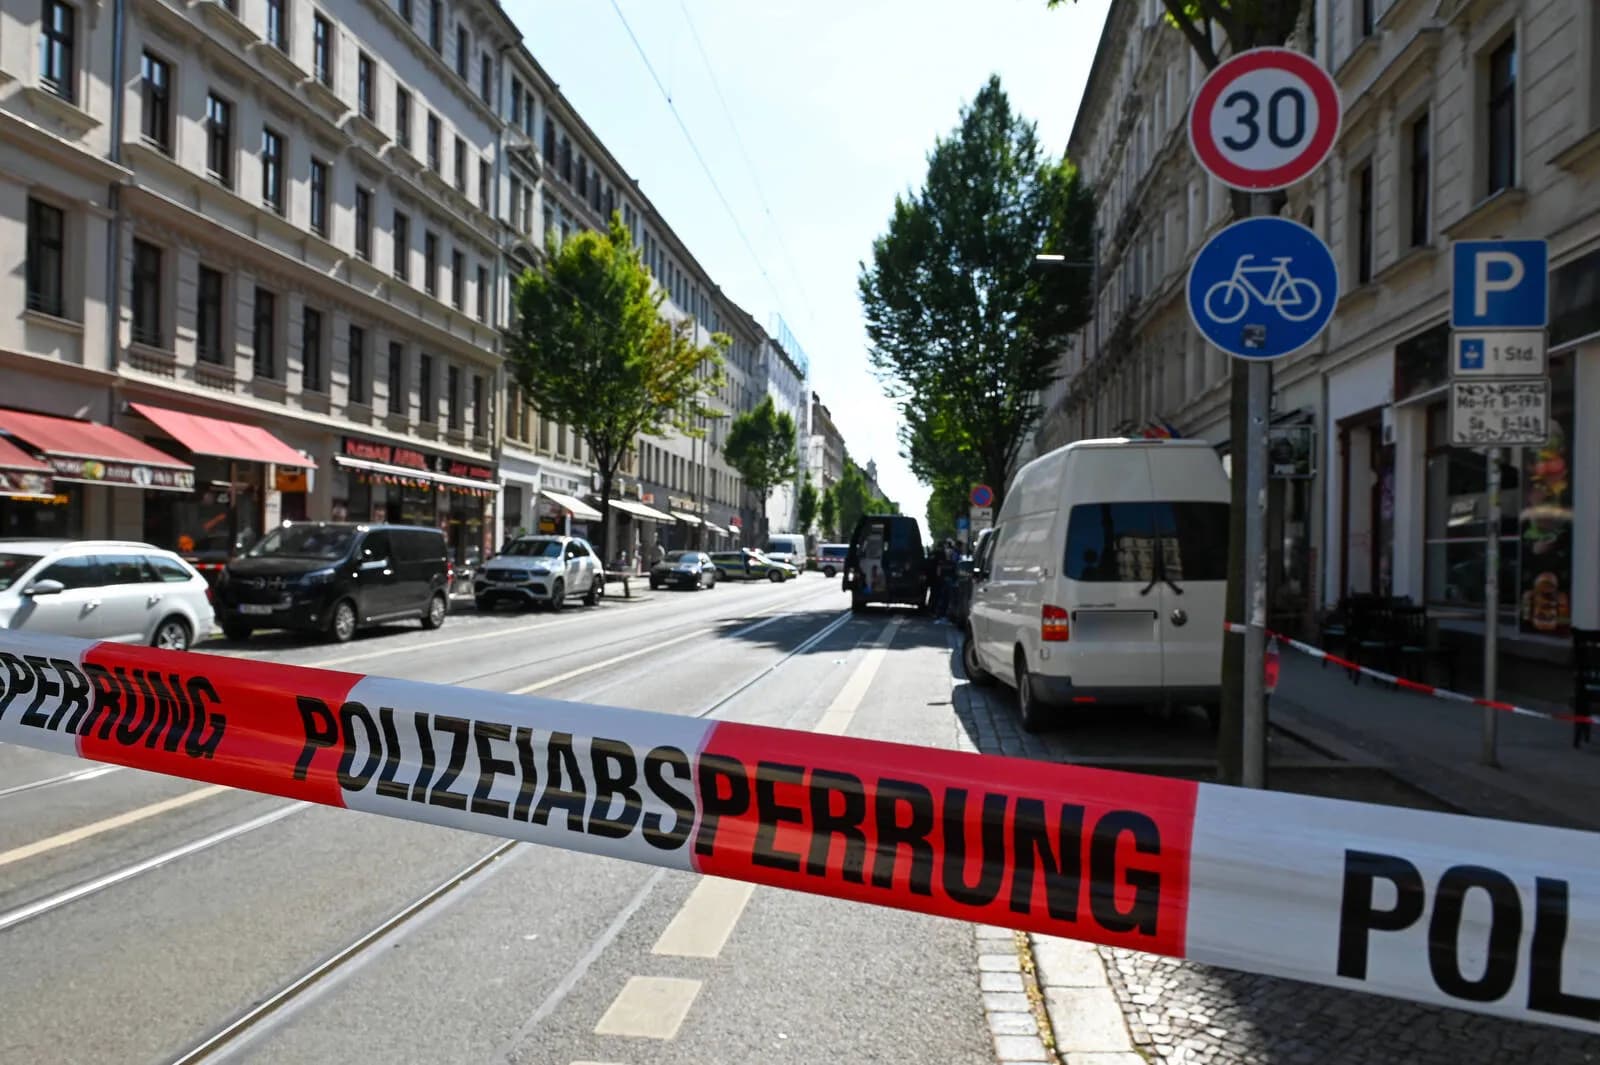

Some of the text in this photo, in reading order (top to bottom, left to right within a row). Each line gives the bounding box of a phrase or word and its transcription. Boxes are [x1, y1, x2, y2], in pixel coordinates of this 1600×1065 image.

[1223, 87, 1306, 151] 30
[1474, 251, 1525, 317] P
[1492, 345, 1537, 361] 1 Std.
[0, 653, 226, 759] PERRUNG
[293, 695, 1161, 937] POLIZEIABSPERRUNG
